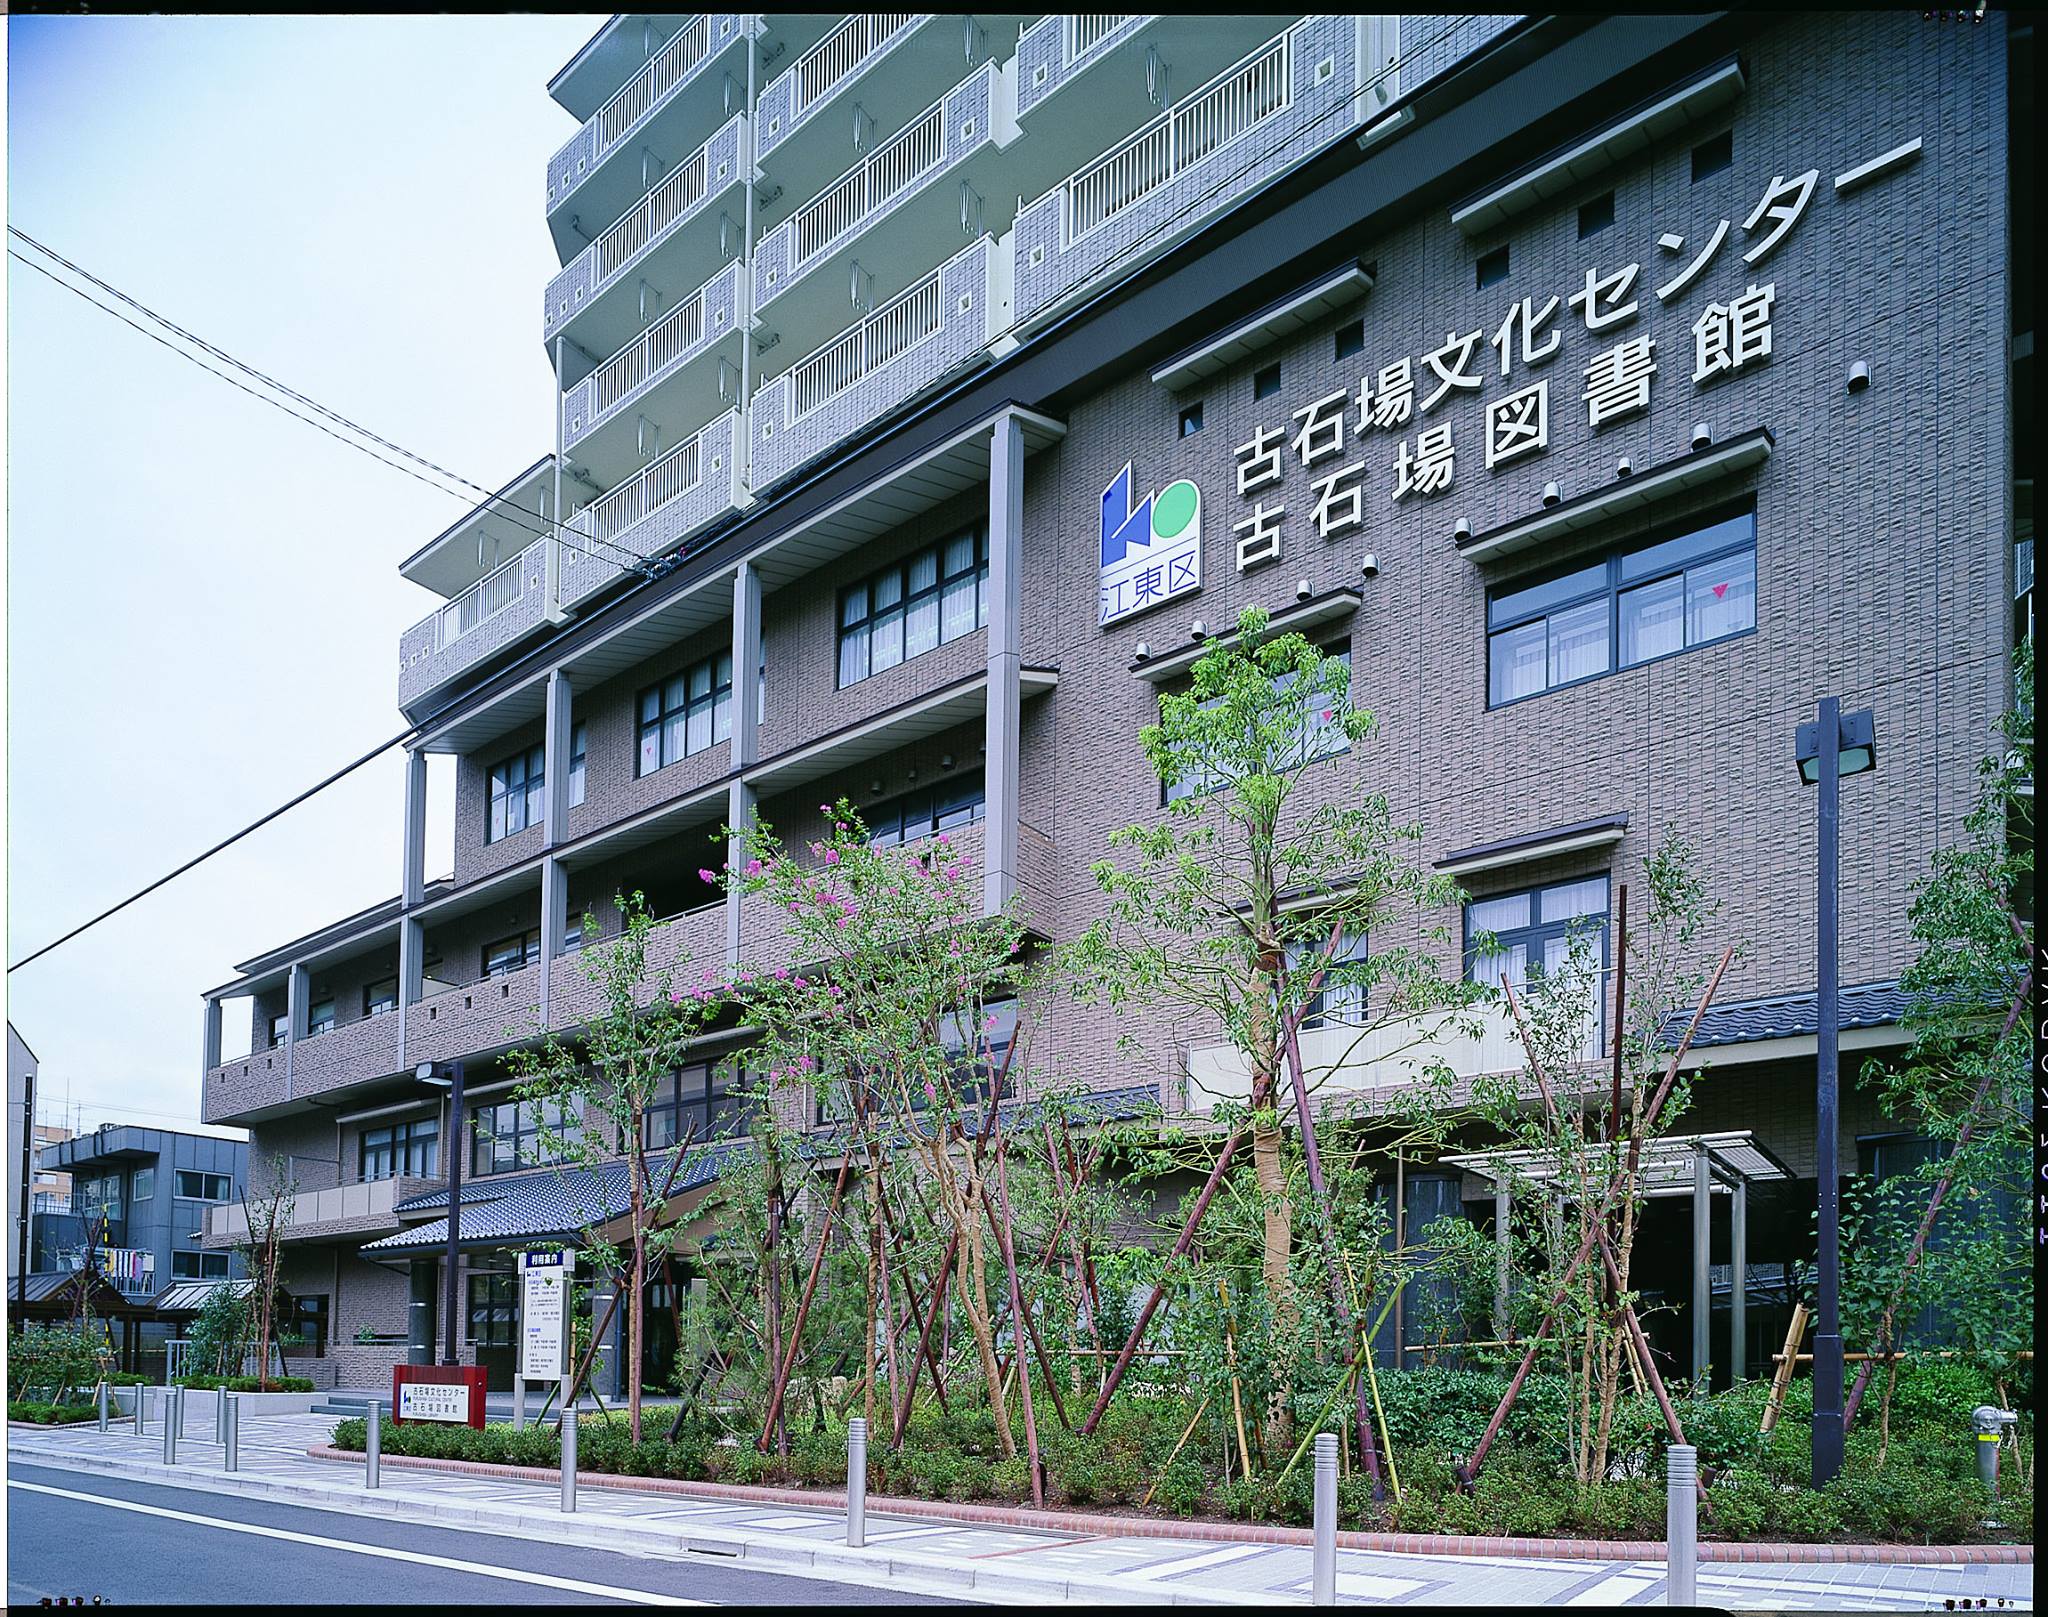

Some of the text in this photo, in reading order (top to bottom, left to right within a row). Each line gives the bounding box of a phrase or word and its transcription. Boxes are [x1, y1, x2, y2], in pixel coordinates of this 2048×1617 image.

[1233, 136, 1923, 497] 古石場文化センター
[1233, 281, 1777, 573] 古石場図書館
[1101, 550, 1197, 621] 江東区
